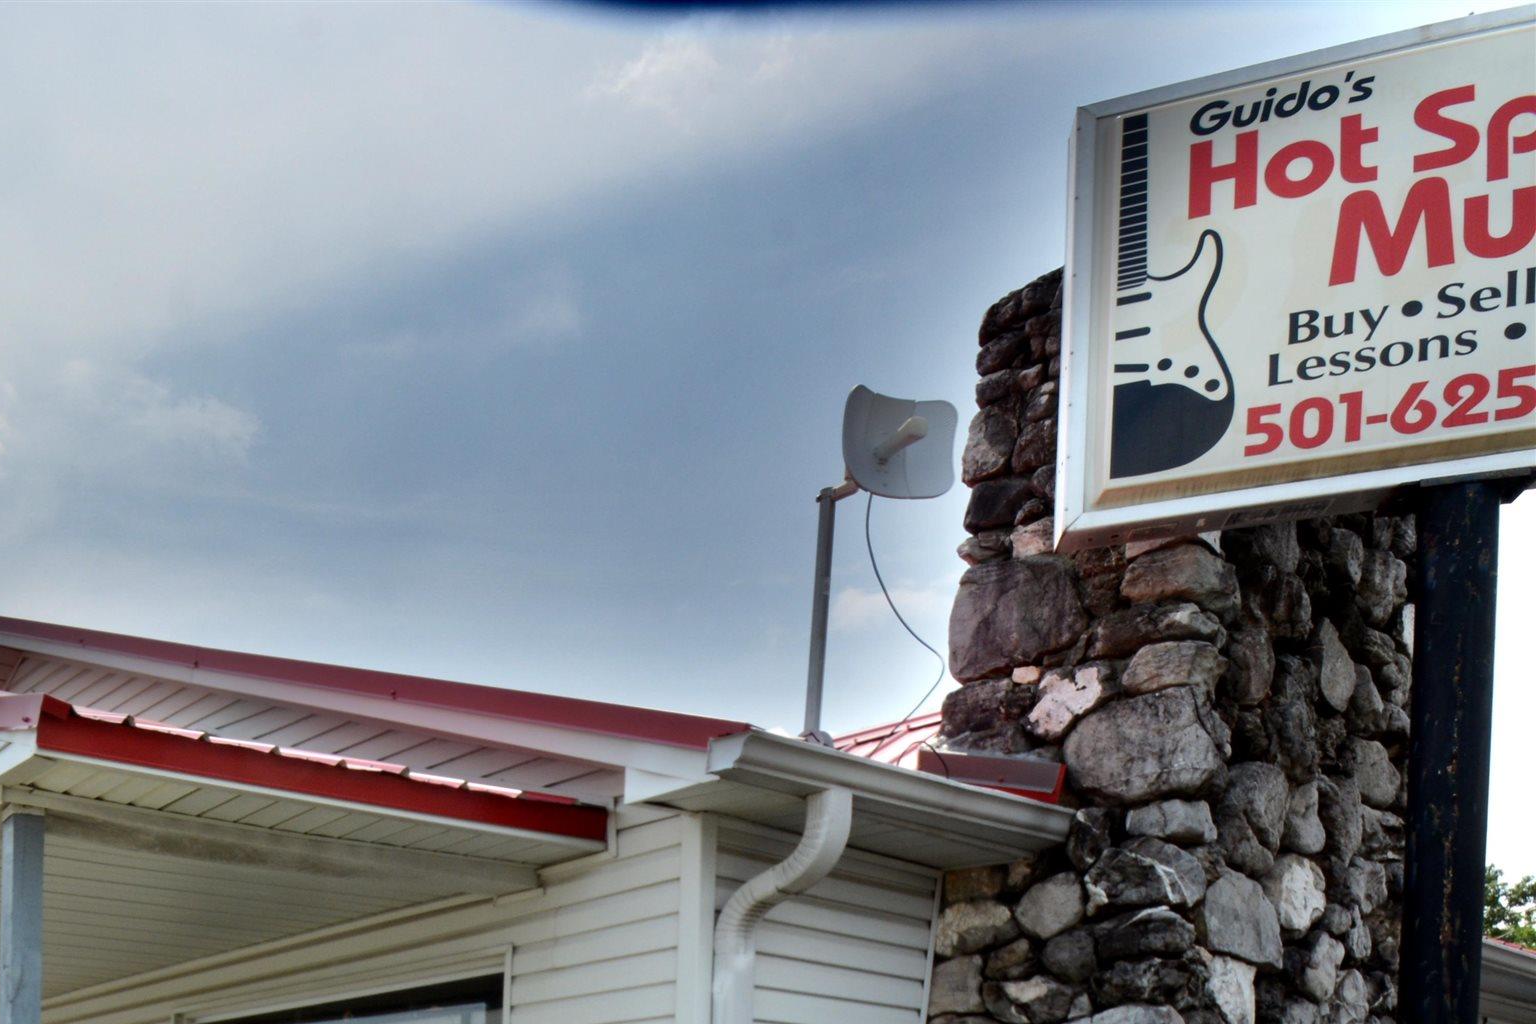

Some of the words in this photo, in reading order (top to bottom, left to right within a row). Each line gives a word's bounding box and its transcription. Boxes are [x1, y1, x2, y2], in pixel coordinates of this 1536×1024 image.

[1189, 70, 1375, 136] Guido's
[1188, 113, 1379, 220] Hot
[1328, 176, 1536, 287] Mu
[1287, 304, 1390, 346] Buy
[1436, 266, 1536, 320] Sell
[1267, 328, 1478, 388] Lessons
